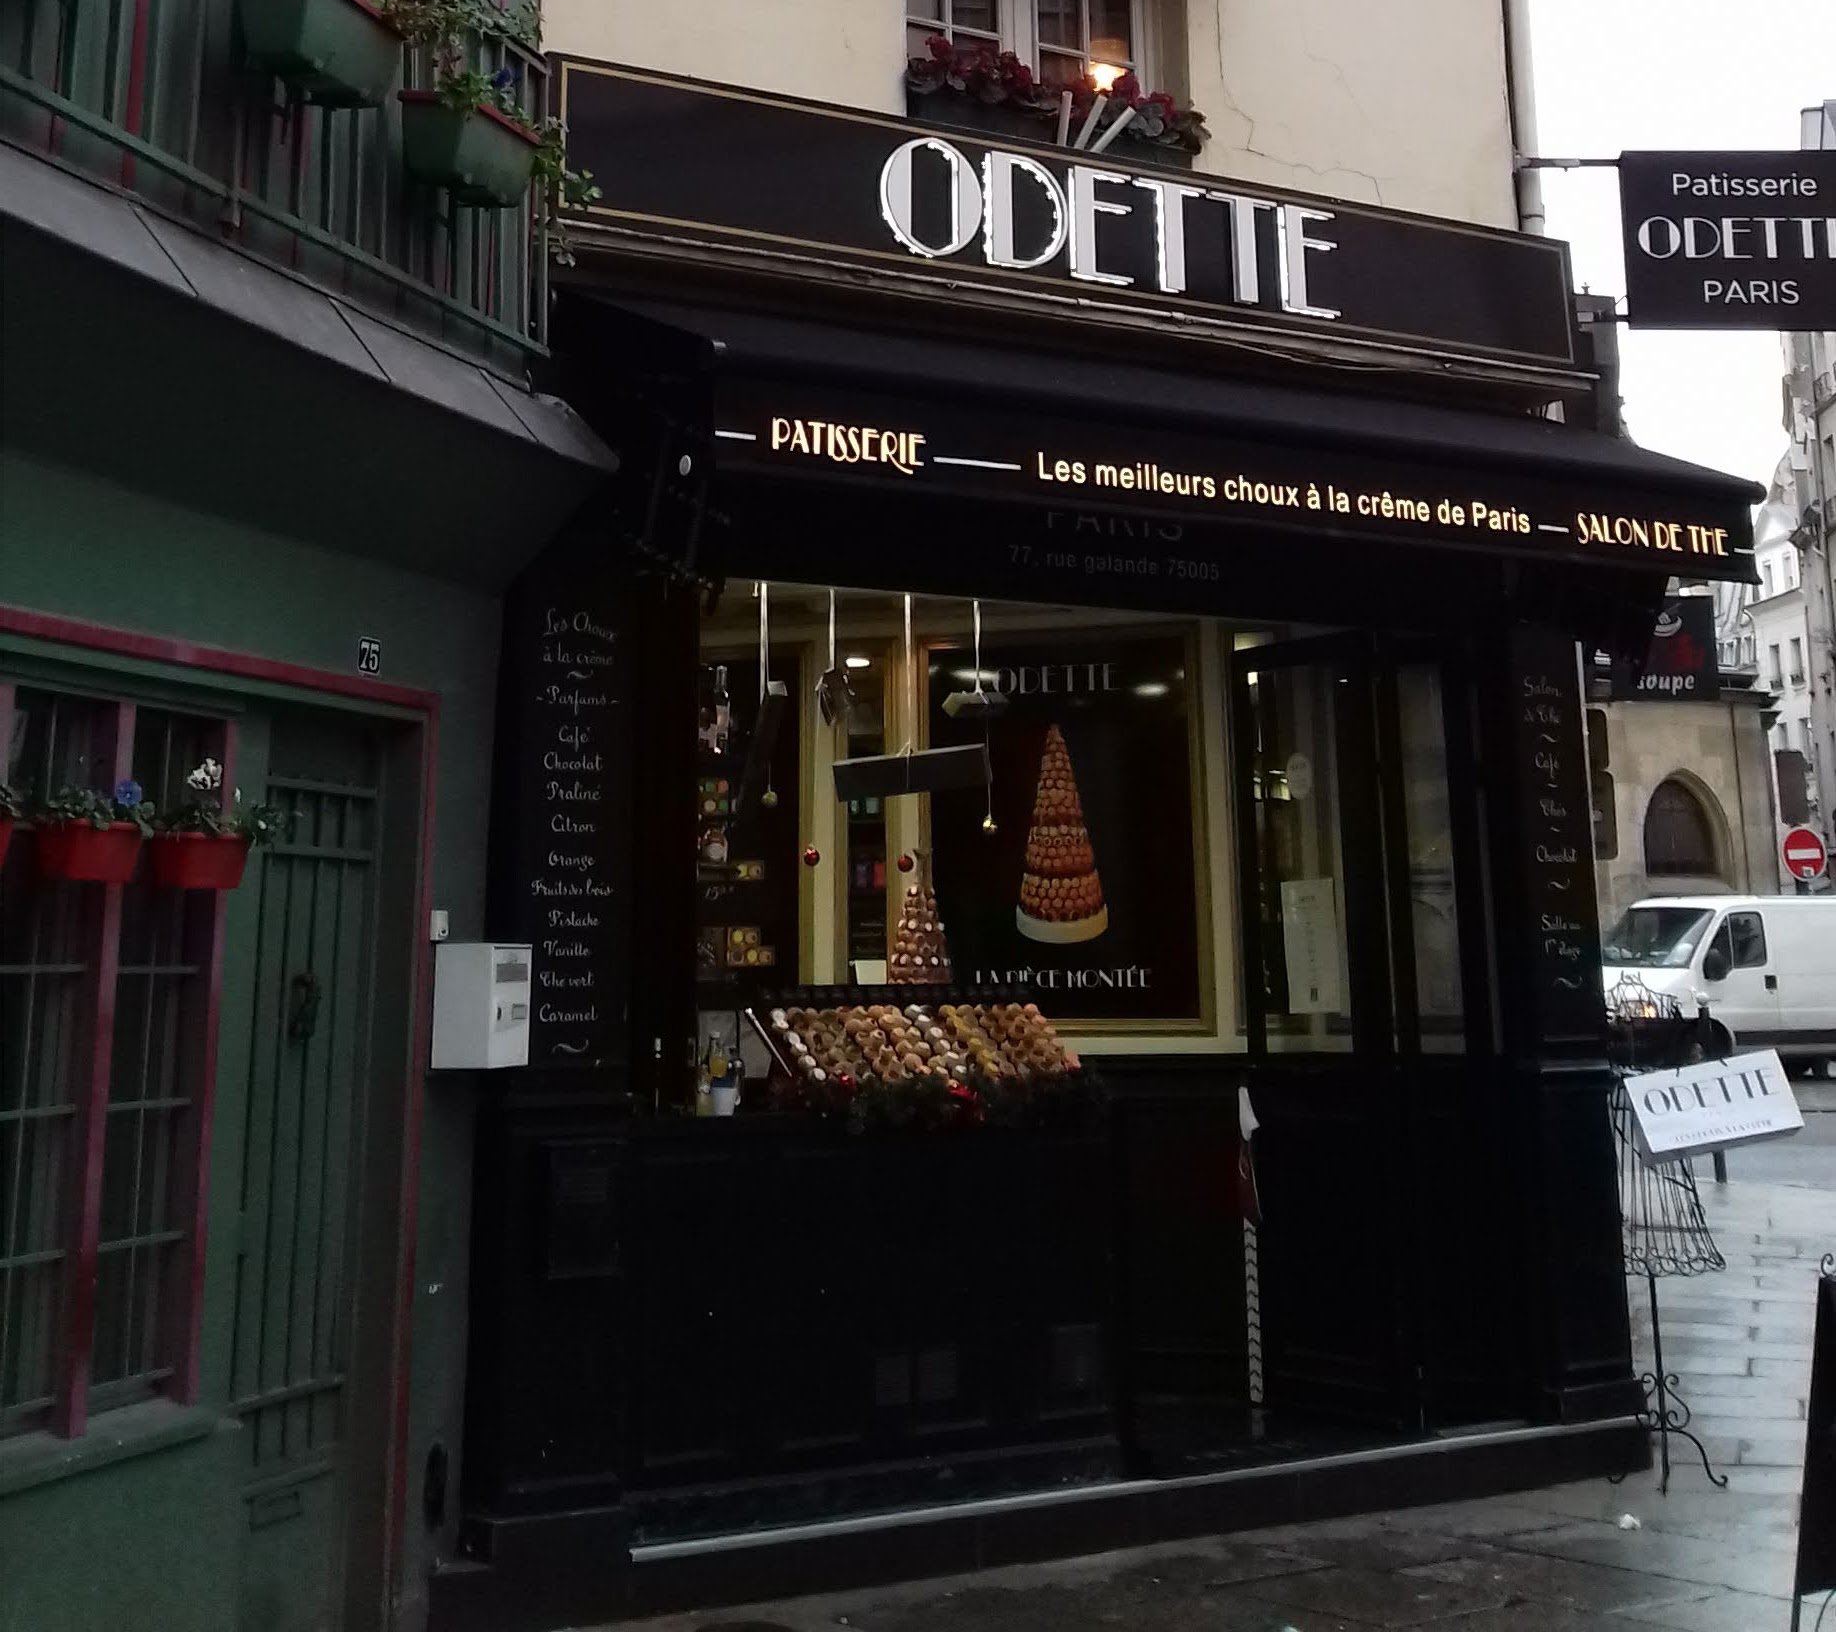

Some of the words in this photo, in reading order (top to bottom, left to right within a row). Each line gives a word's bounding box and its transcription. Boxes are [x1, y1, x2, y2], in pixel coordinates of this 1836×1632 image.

[1672, 172, 1818, 197] Patisserie
[879, 137, 1342, 319] ODETTE
[1703, 279, 1801, 305] PARIS
[771, 417, 926, 475] PATISSERIE
[1037, 451, 1087, 484] Les
[1095, 463, 1216, 498] meilleurs
[1224, 474, 1300, 508] choux
[1306, 482, 1322, 510] à
[1327, 484, 1351, 514] la
[1437, 498, 1466, 527] de
[1472, 501, 1532, 535] Paris
[1577, 512, 1651, 548] SALON
[1653, 520, 1684, 552] DE
[1686, 524, 1730, 557] THE
[1046, 552, 1076, 569] rue
[1084, 552, 1158, 576] galande
[1167, 558, 1221, 582] 75005
[541, 607, 569, 638] Les
[359, 640, 381, 672] 75
[557, 641, 572, 665] la
[992, 663, 1122, 697] ODETTE
[558, 724, 591, 751] Café
[543, 751, 603, 771] Chocolat
[546, 779, 602, 802] Praliné
[550, 813, 597, 834] Citron
[547, 850, 597, 872] Orange
[543, 939, 592, 958] Vanille
[1066, 965, 1153, 990] MONTÉE
[538, 1002, 600, 1024] Caramel
[1644, 1068, 1780, 1115] ODETTE
